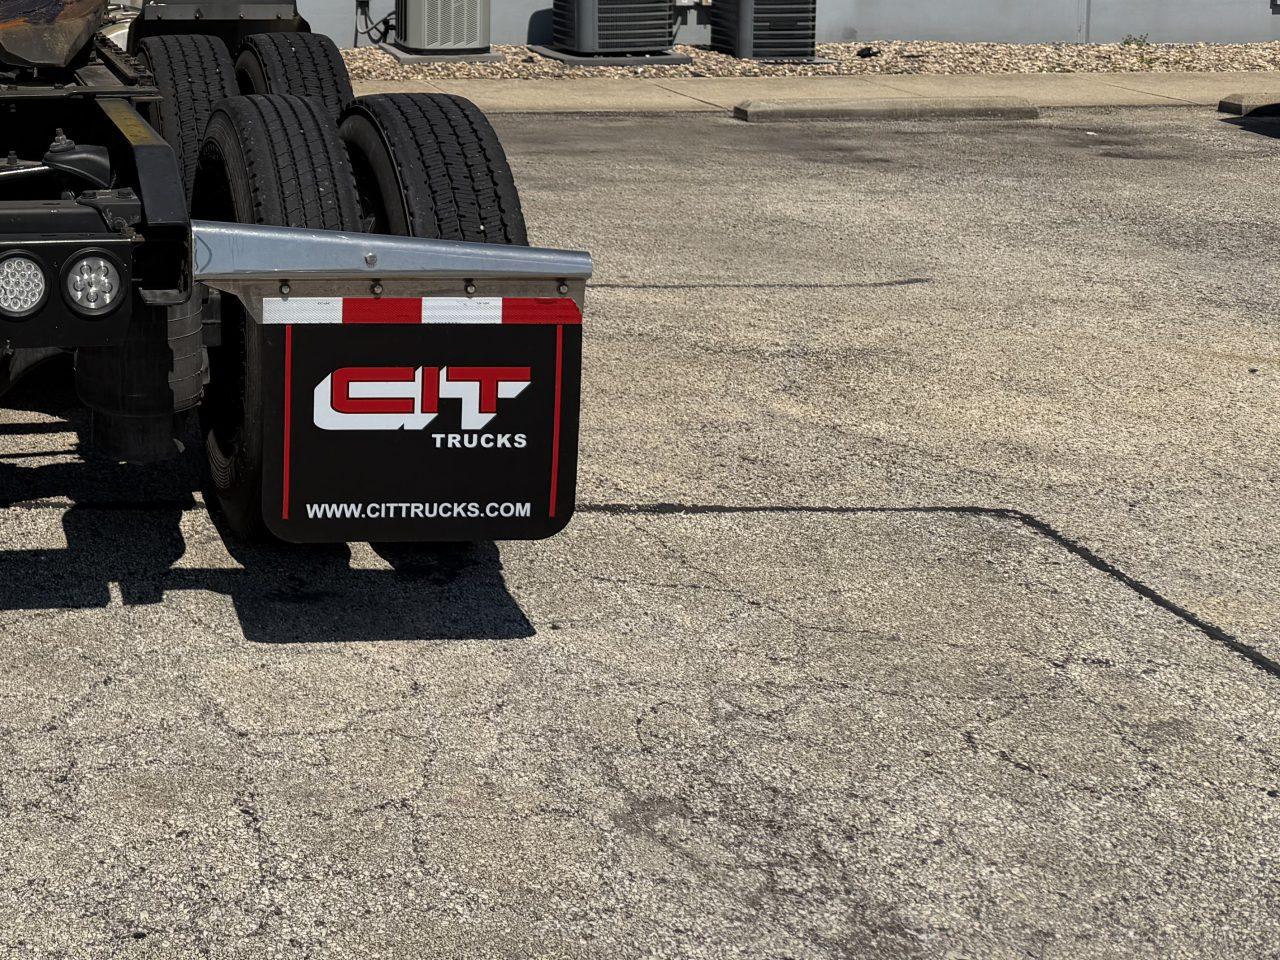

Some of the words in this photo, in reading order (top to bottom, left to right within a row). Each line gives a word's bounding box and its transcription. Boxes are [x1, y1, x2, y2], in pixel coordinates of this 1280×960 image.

[313, 365, 531, 430] CIT
[431, 433, 527, 448] TRUCKS
[306, 502, 531, 518] WWW.CITTRUCKS.COM
